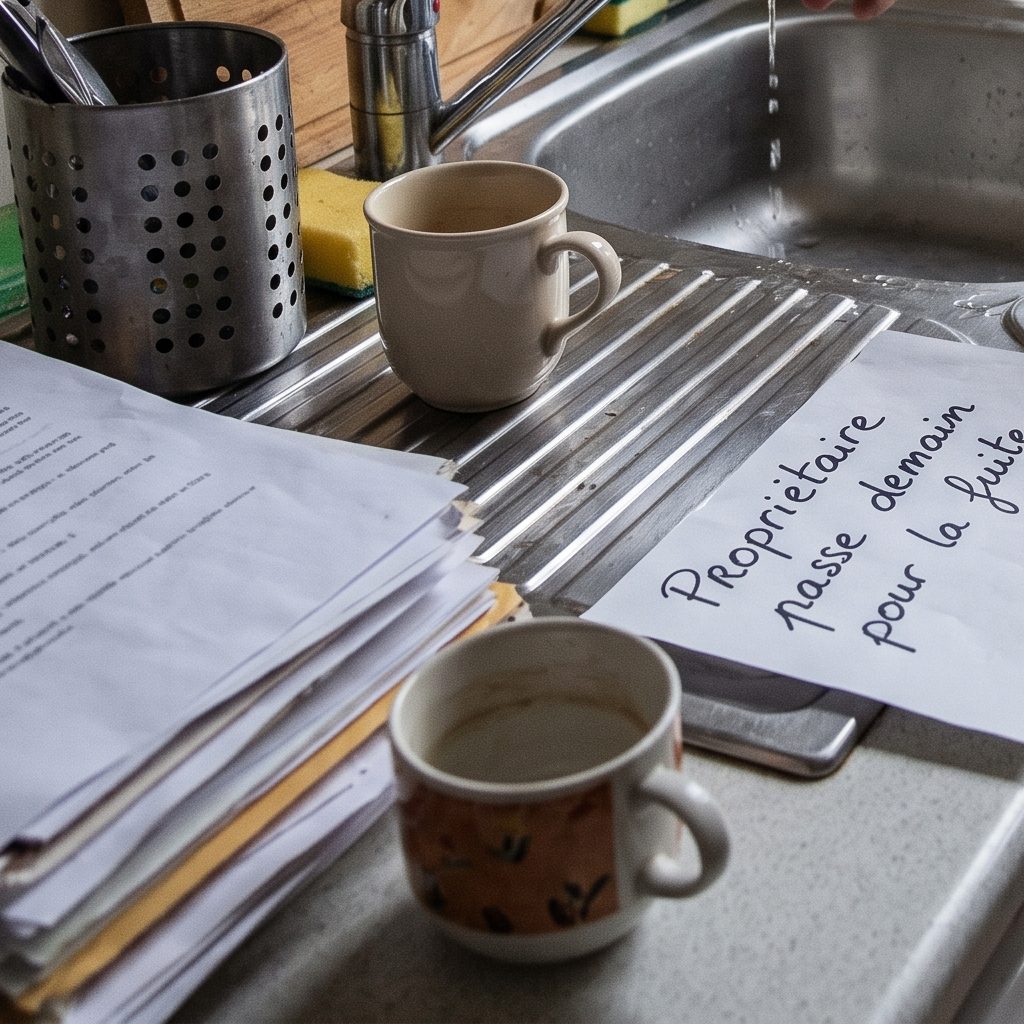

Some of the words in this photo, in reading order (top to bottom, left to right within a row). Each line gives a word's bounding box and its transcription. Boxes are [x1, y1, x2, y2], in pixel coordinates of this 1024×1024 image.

[774, 533, 867, 632] passe
[858, 404, 975, 512] demain
[861, 564, 926, 653] pour
[906, 521, 970, 548] la
